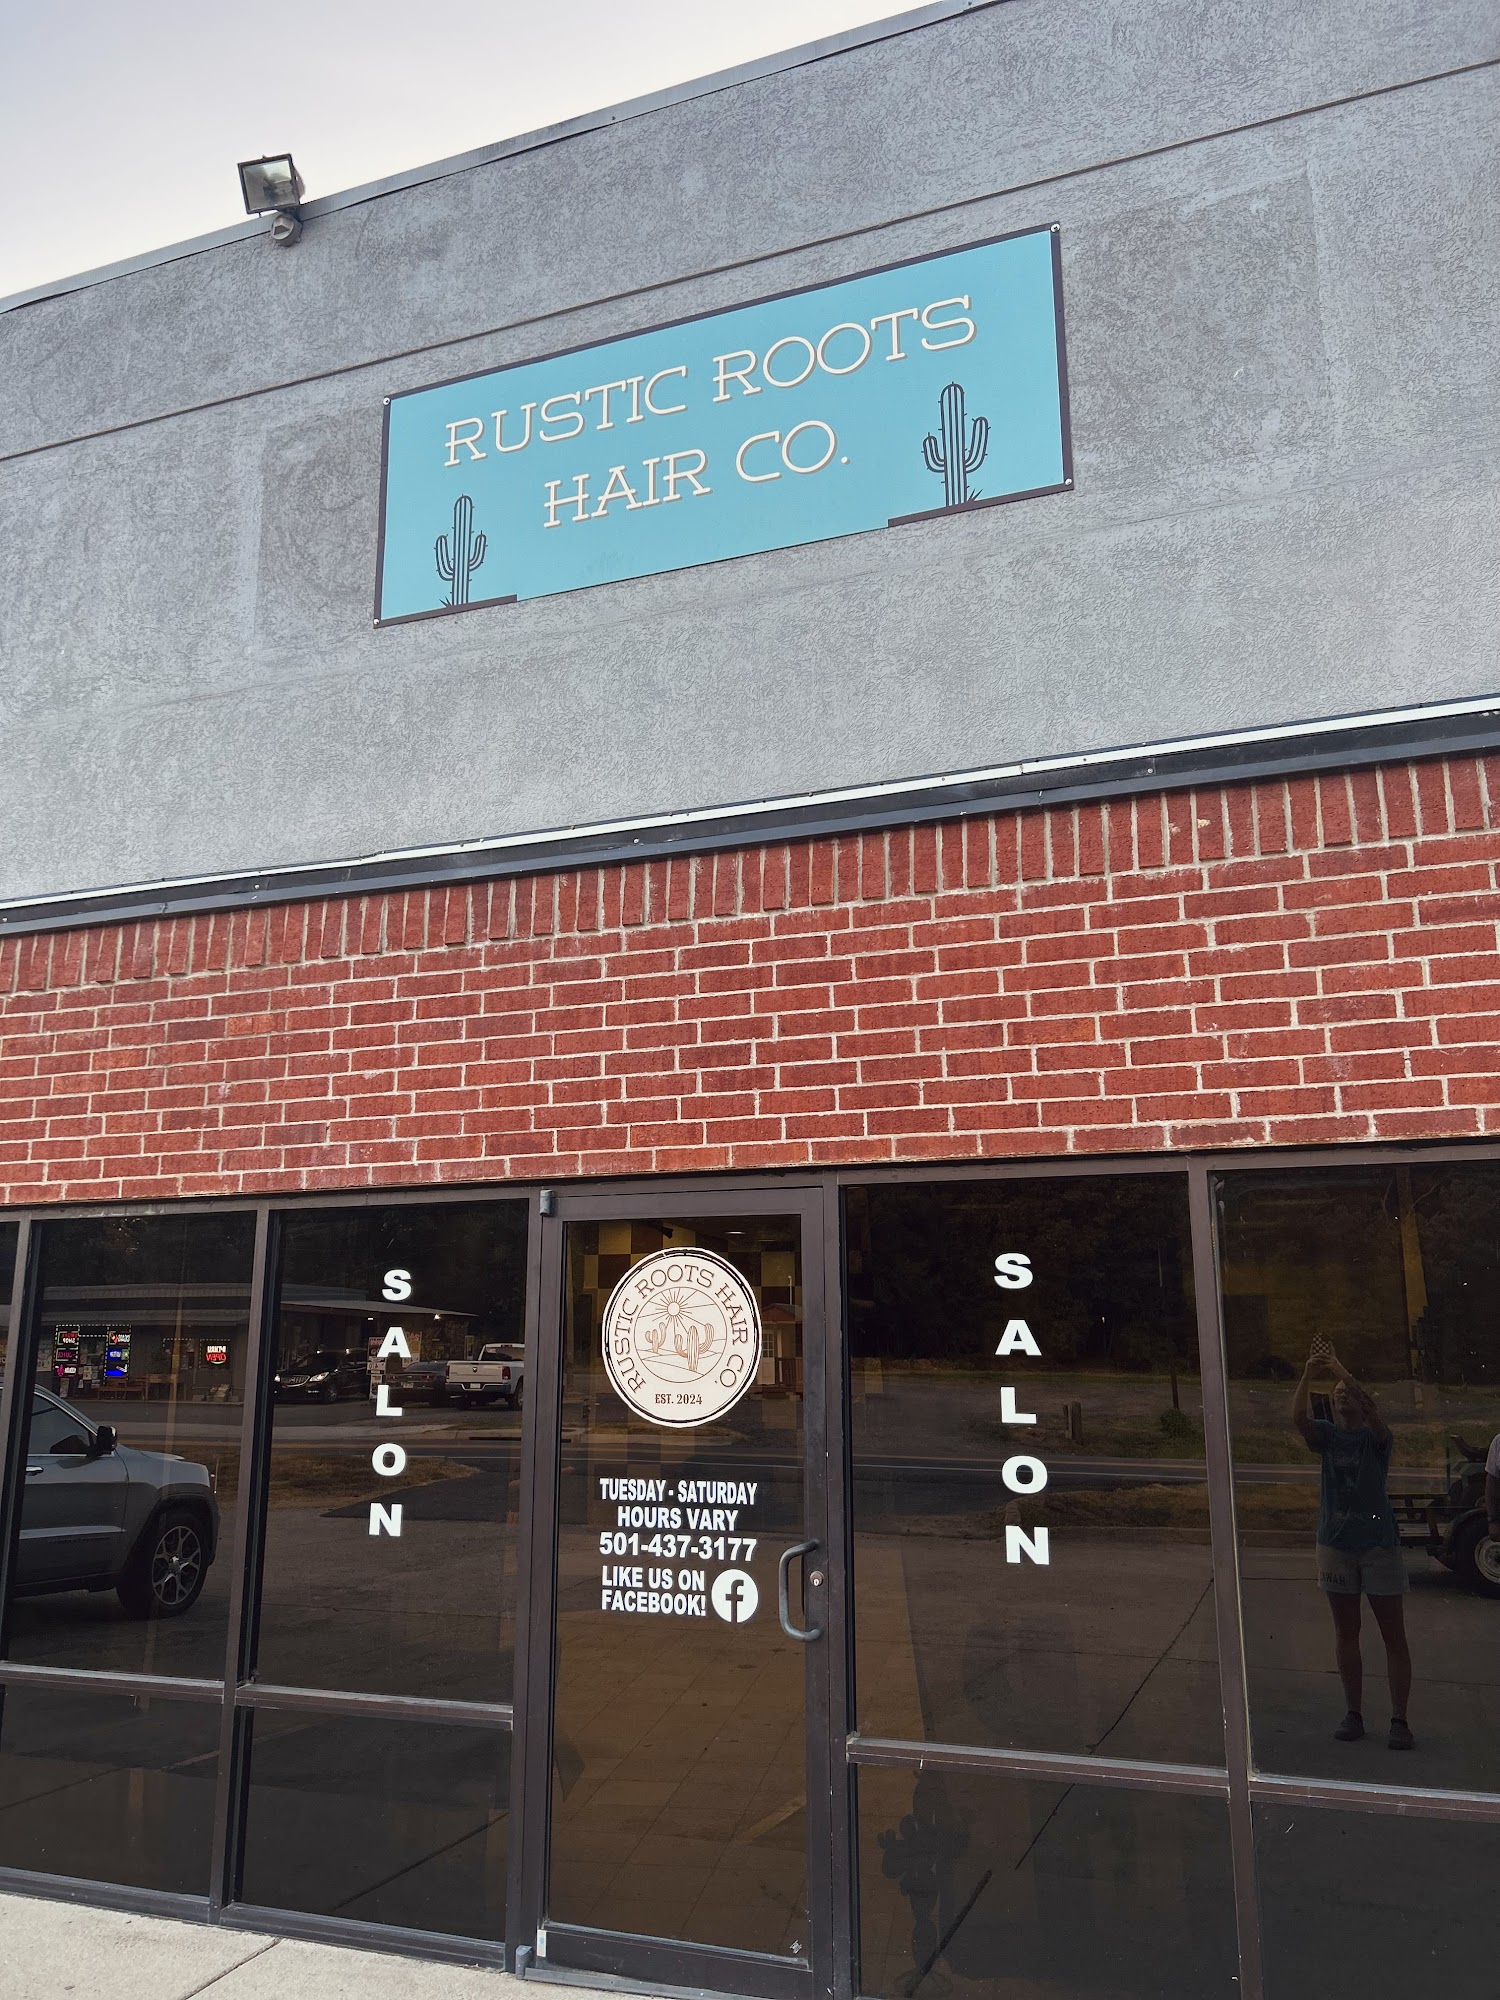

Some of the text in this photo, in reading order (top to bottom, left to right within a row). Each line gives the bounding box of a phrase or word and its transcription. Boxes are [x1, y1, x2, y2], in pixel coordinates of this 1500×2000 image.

[444, 295, 977, 468] RUSTIC ROOTS
[544, 420, 850, 528] HAIR CO.
[614, 1298, 647, 1394] RUSTIC
[634, 1264, 715, 1300] ROOTS
[714, 1282, 749, 1346] HAIR
[368, 1270, 412, 1536] SALON
[655, 1393, 703, 1405] EST. 2024
[995, 1253, 1050, 1565] SALON
[599, 1477, 666, 1502] TUESDAY
[677, 1480, 758, 1505] SATURDAY
[617, 1506, 739, 1532] HOURS VARY
[599, 1531, 757, 1562] 501-437-3177
[602, 1565, 705, 1592] LIKE US ON
[601, 1589, 707, 1617] FACEBOOK!
